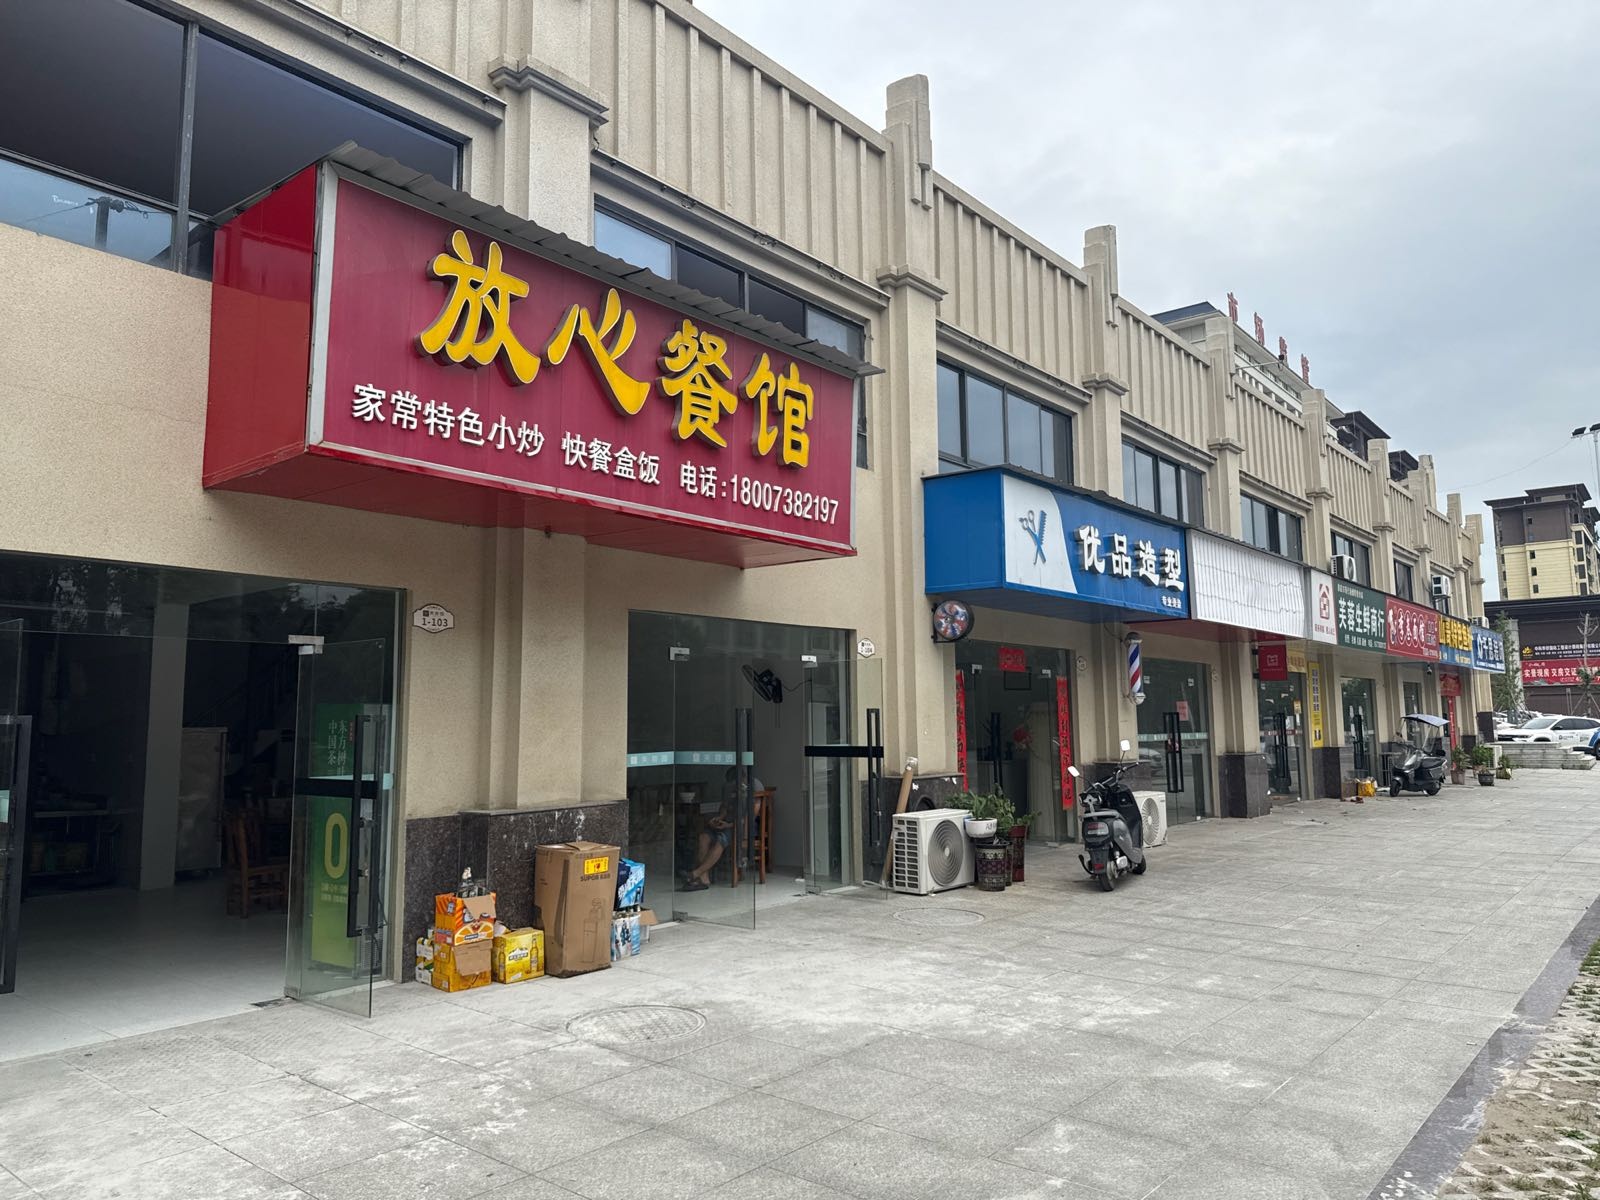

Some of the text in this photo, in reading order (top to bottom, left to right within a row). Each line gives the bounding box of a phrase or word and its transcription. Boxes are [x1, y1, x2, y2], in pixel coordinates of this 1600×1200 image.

[417, 229, 815, 469] 放心餐馆
[351, 383, 840, 525] 家常特色小炒 快餐盒饭 电话:18007382197
[1077, 525, 1185, 592] 优品造型
[421, 617, 448, 627] 1-103
[1338, 597, 1385, 638] 芙蓉生鲜商行
